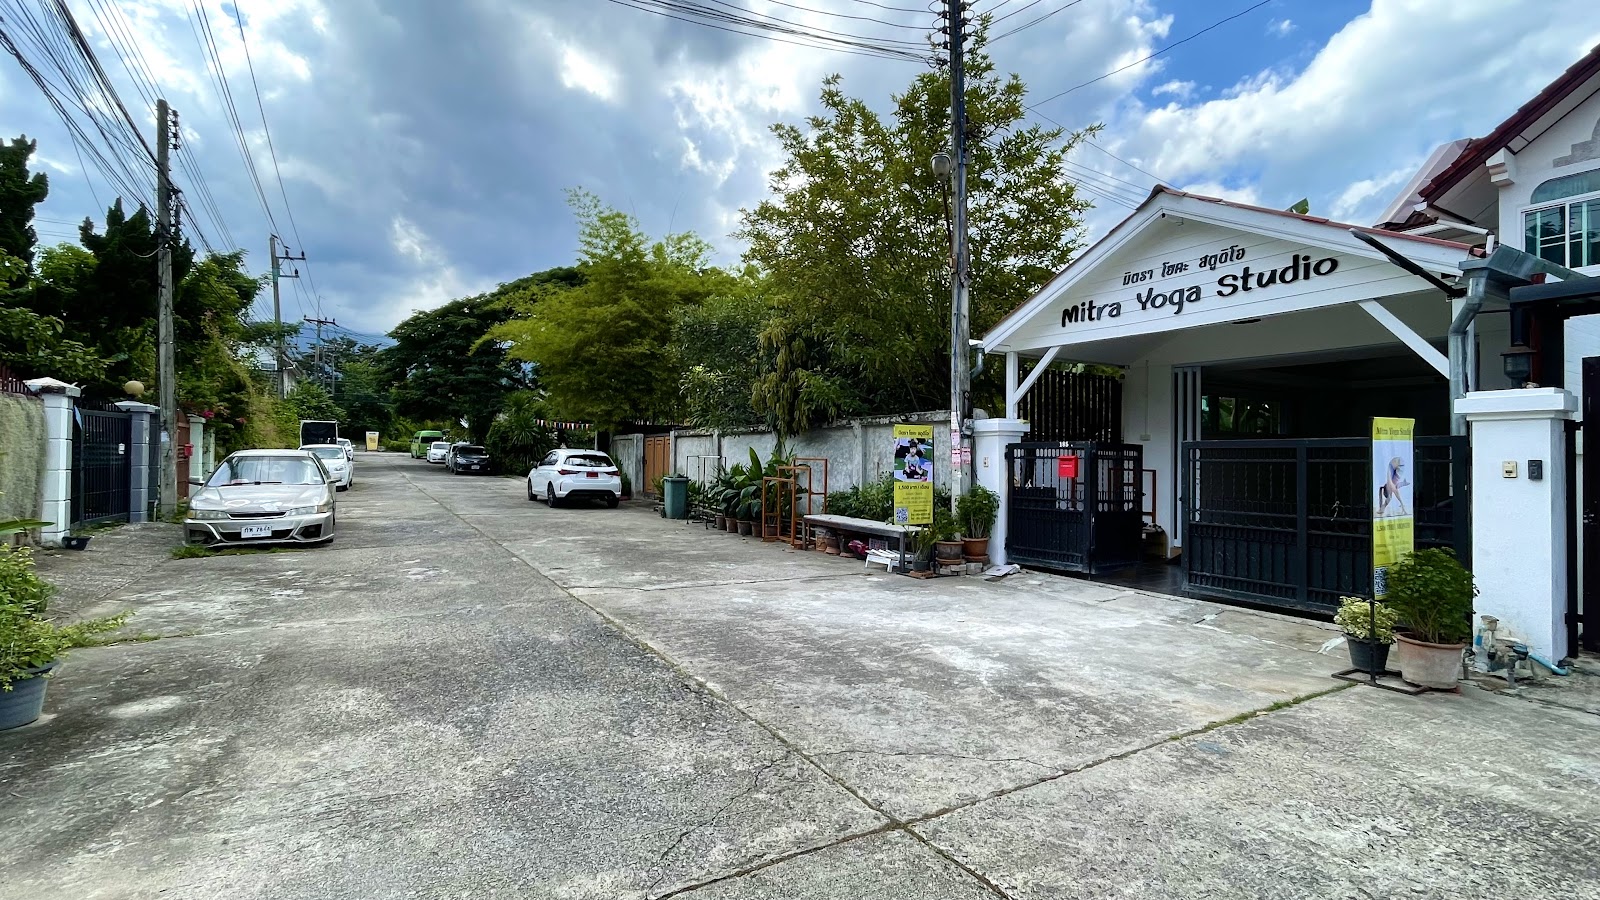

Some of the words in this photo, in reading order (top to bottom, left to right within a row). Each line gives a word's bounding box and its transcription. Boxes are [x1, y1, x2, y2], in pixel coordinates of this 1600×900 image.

[1061, 299, 1122, 328] Mitra
[1136, 284, 1202, 315] Yoga
[1216, 253, 1339, 298] Studio
[1161, 261, 1190, 278] โยคะ
